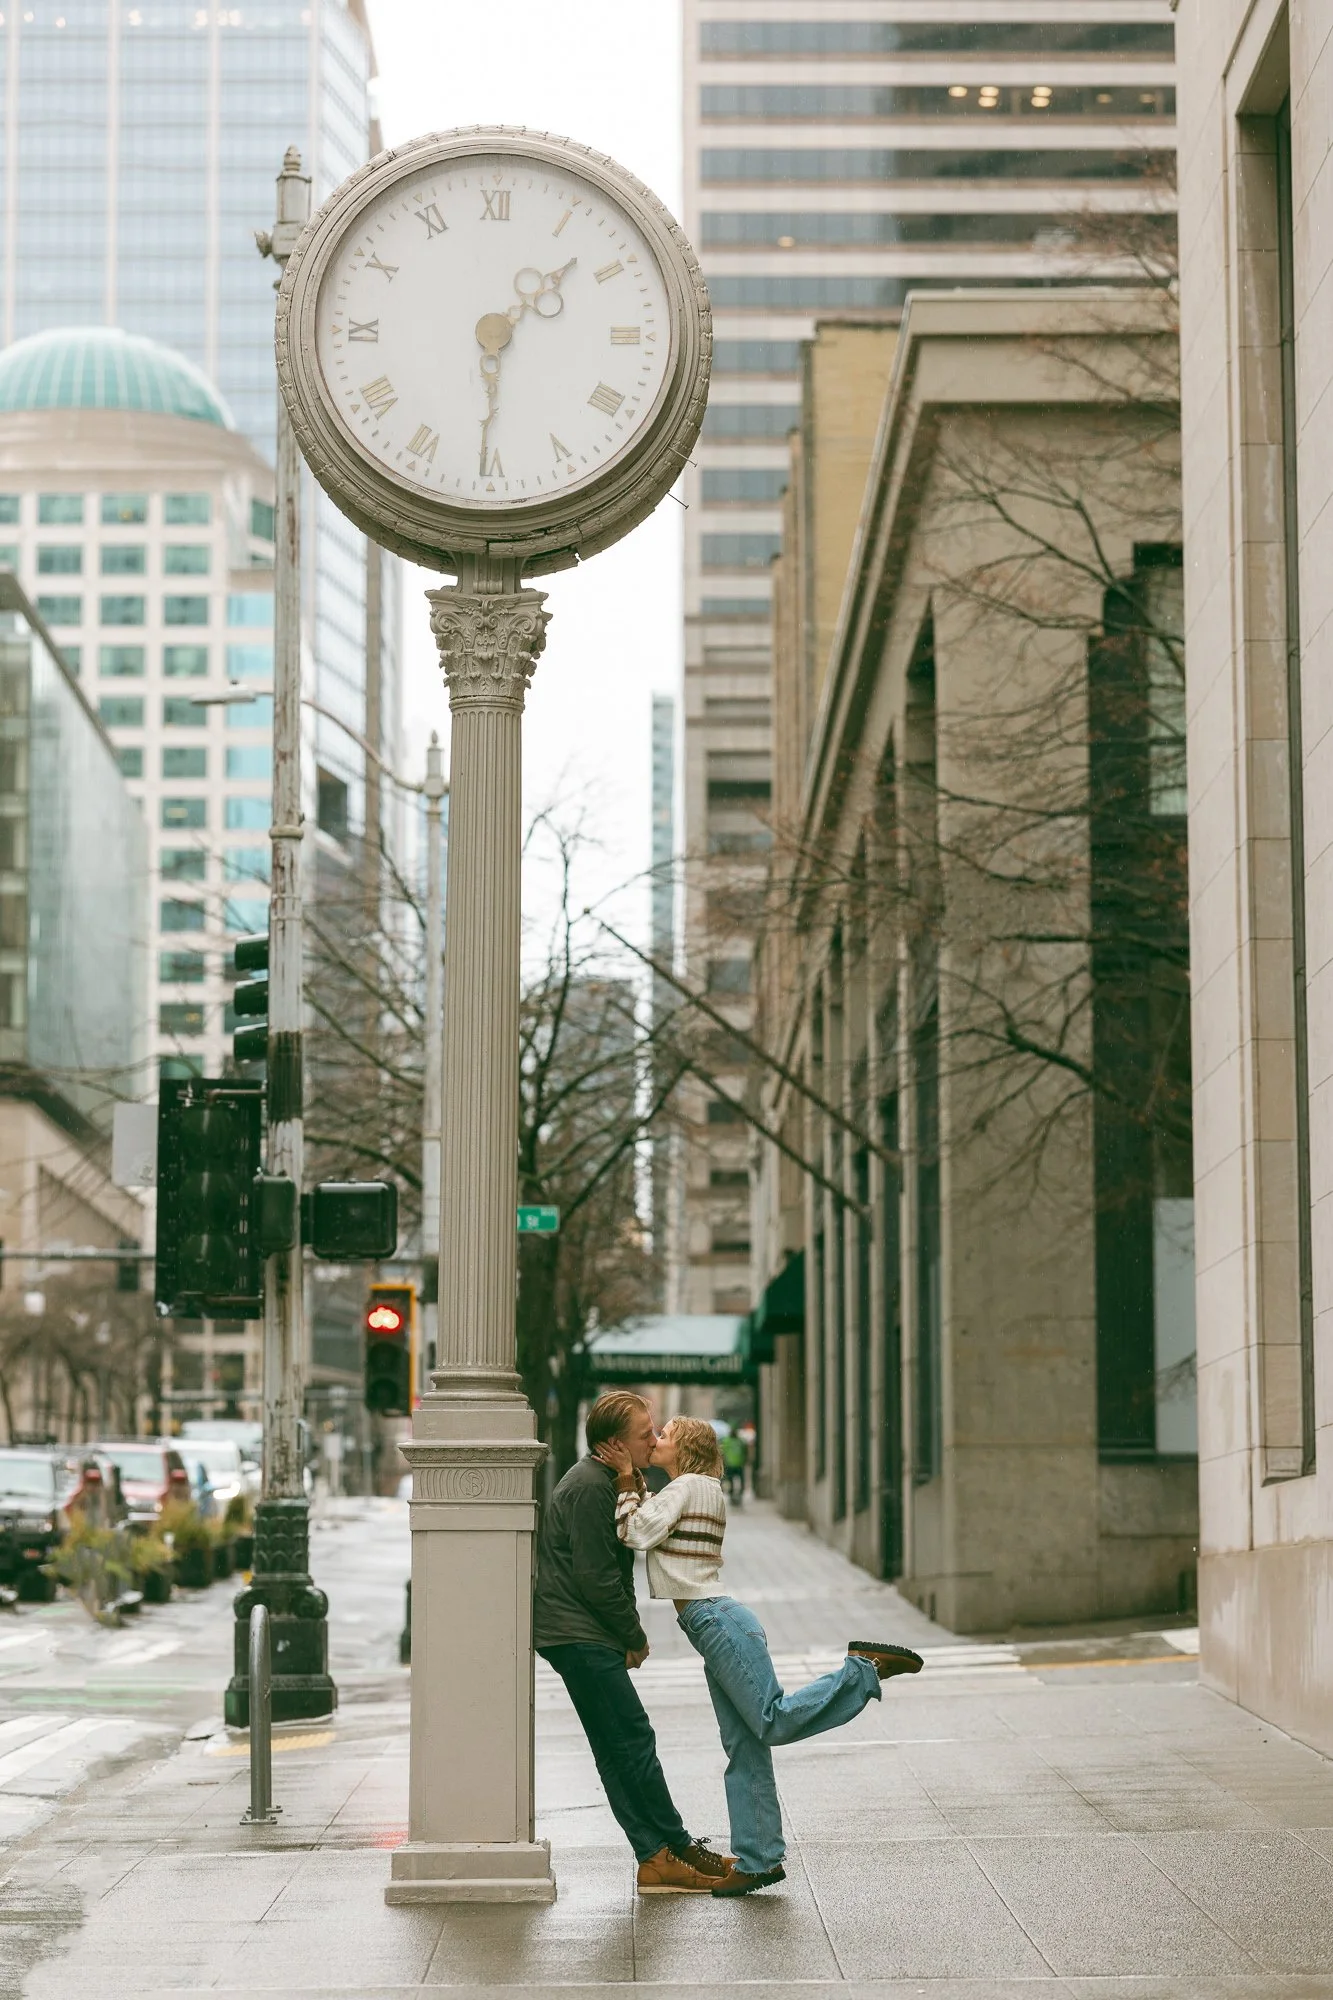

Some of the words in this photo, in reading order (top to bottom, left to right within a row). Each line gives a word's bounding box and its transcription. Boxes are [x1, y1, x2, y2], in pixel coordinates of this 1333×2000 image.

[413, 202, 450, 240] XI
[479, 189, 511, 221] XII
[551, 208, 574, 238] I
[364, 250, 400, 283] X
[593, 258, 625, 285] II
[348, 316, 379, 343] IX
[610, 326, 641, 345] III
[359, 374, 399, 420] VIII
[586, 380, 626, 418] IIII
[406, 423, 440, 464] VII
[549, 432, 573, 463] V
